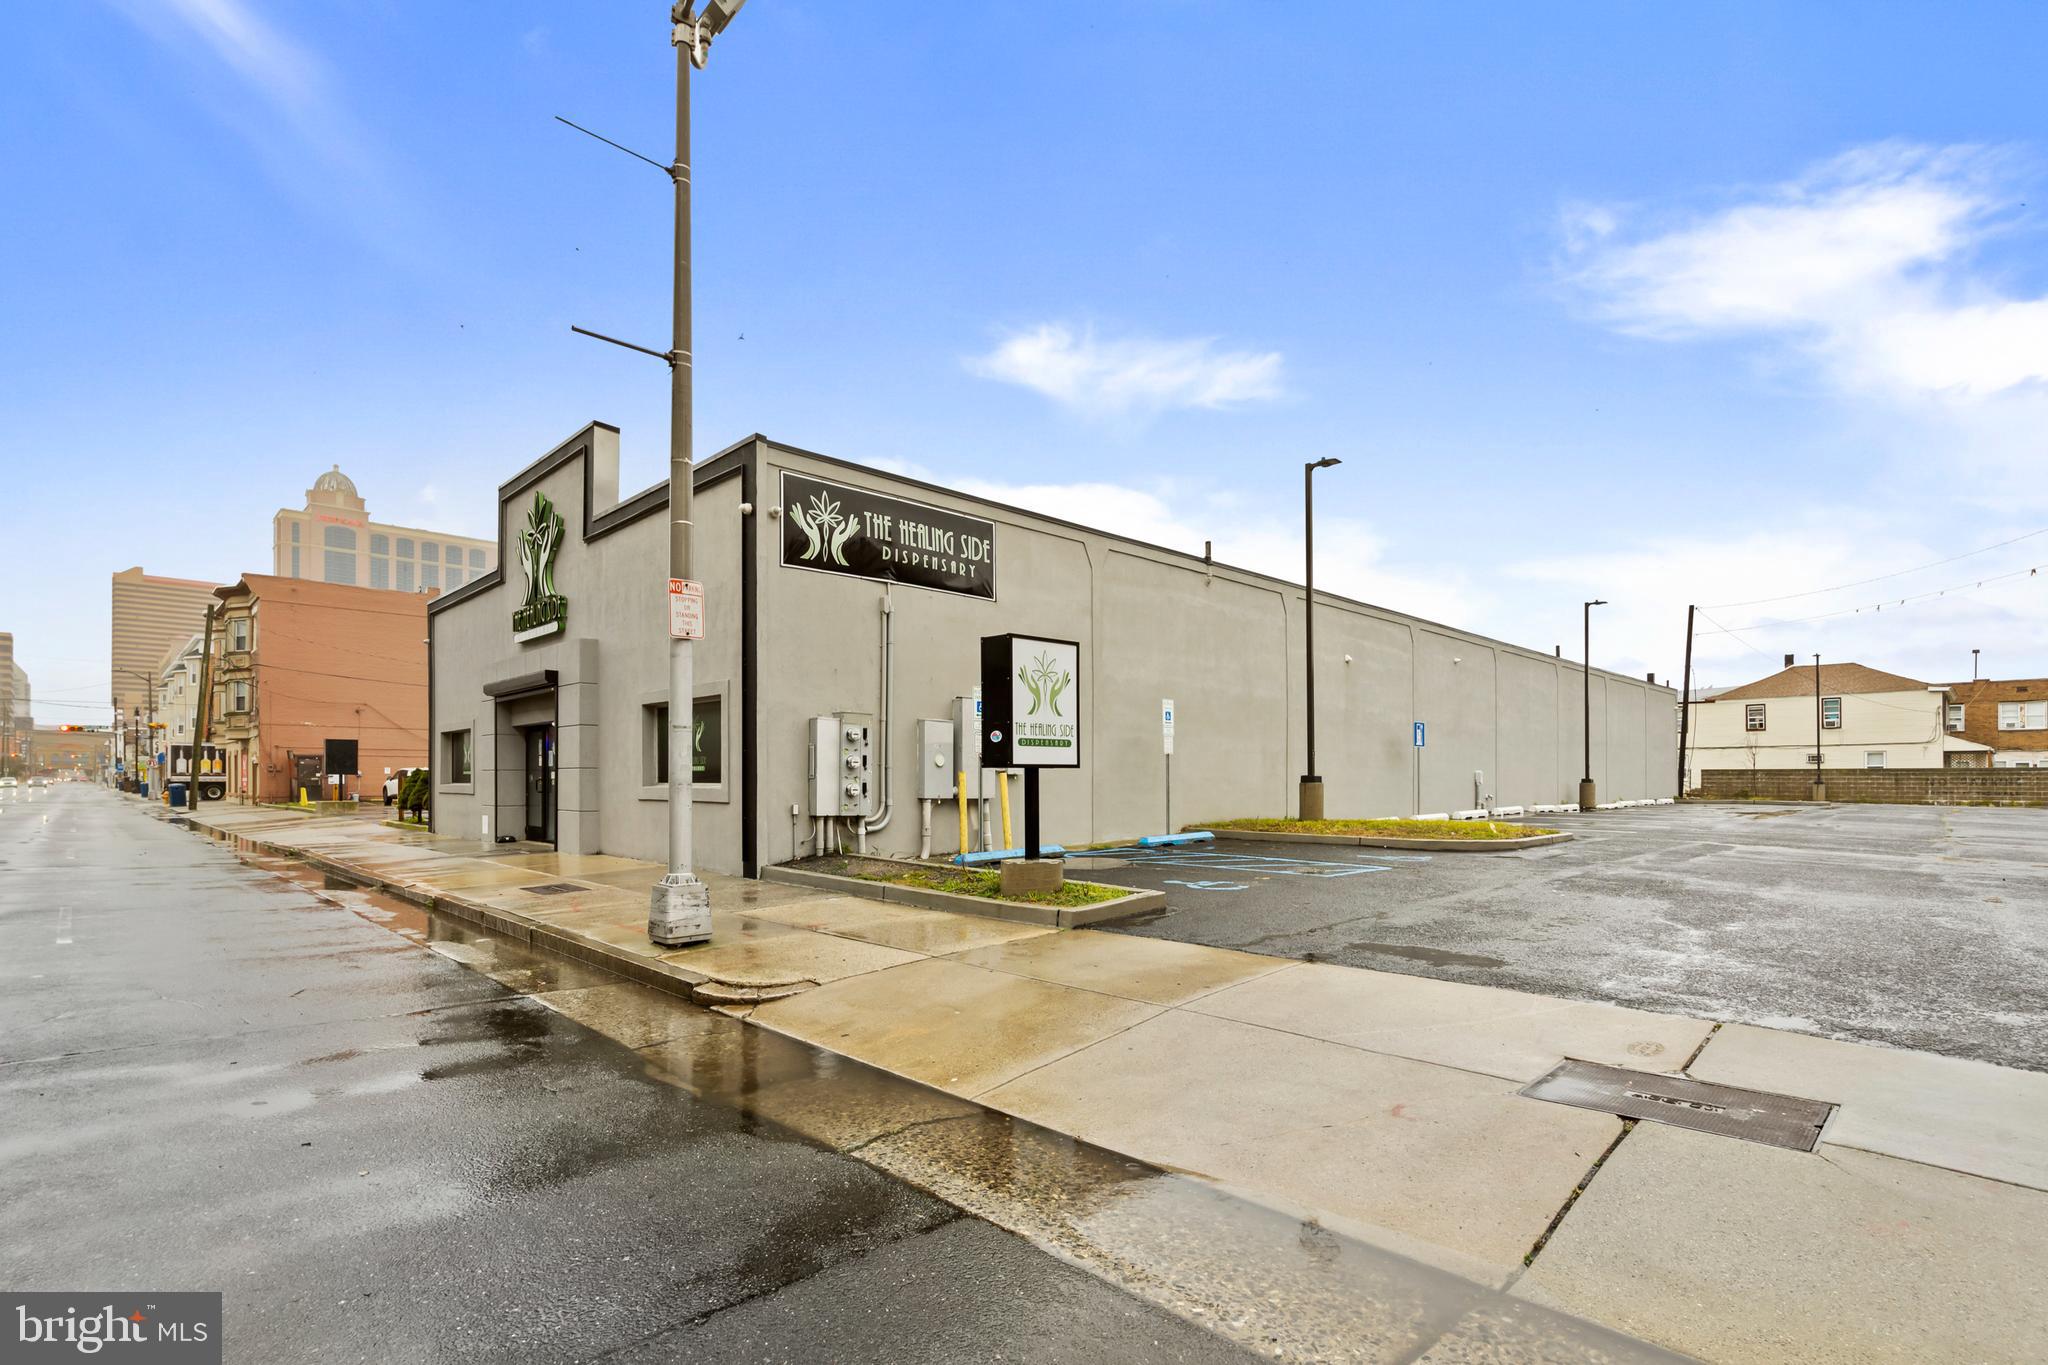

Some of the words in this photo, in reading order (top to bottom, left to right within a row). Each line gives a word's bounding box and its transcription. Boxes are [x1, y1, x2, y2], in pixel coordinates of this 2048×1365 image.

[864, 511, 892, 542] THE
[899, 519, 955, 556] HEALING
[960, 534, 991, 563] SIDE
[882, 545, 976, 578] DISPENSARY
[670, 581, 681, 592] NO
[1015, 722, 1026, 736] THE
[1030, 722, 1056, 737] HEALING
[1060, 724, 1074, 738] SIDE
